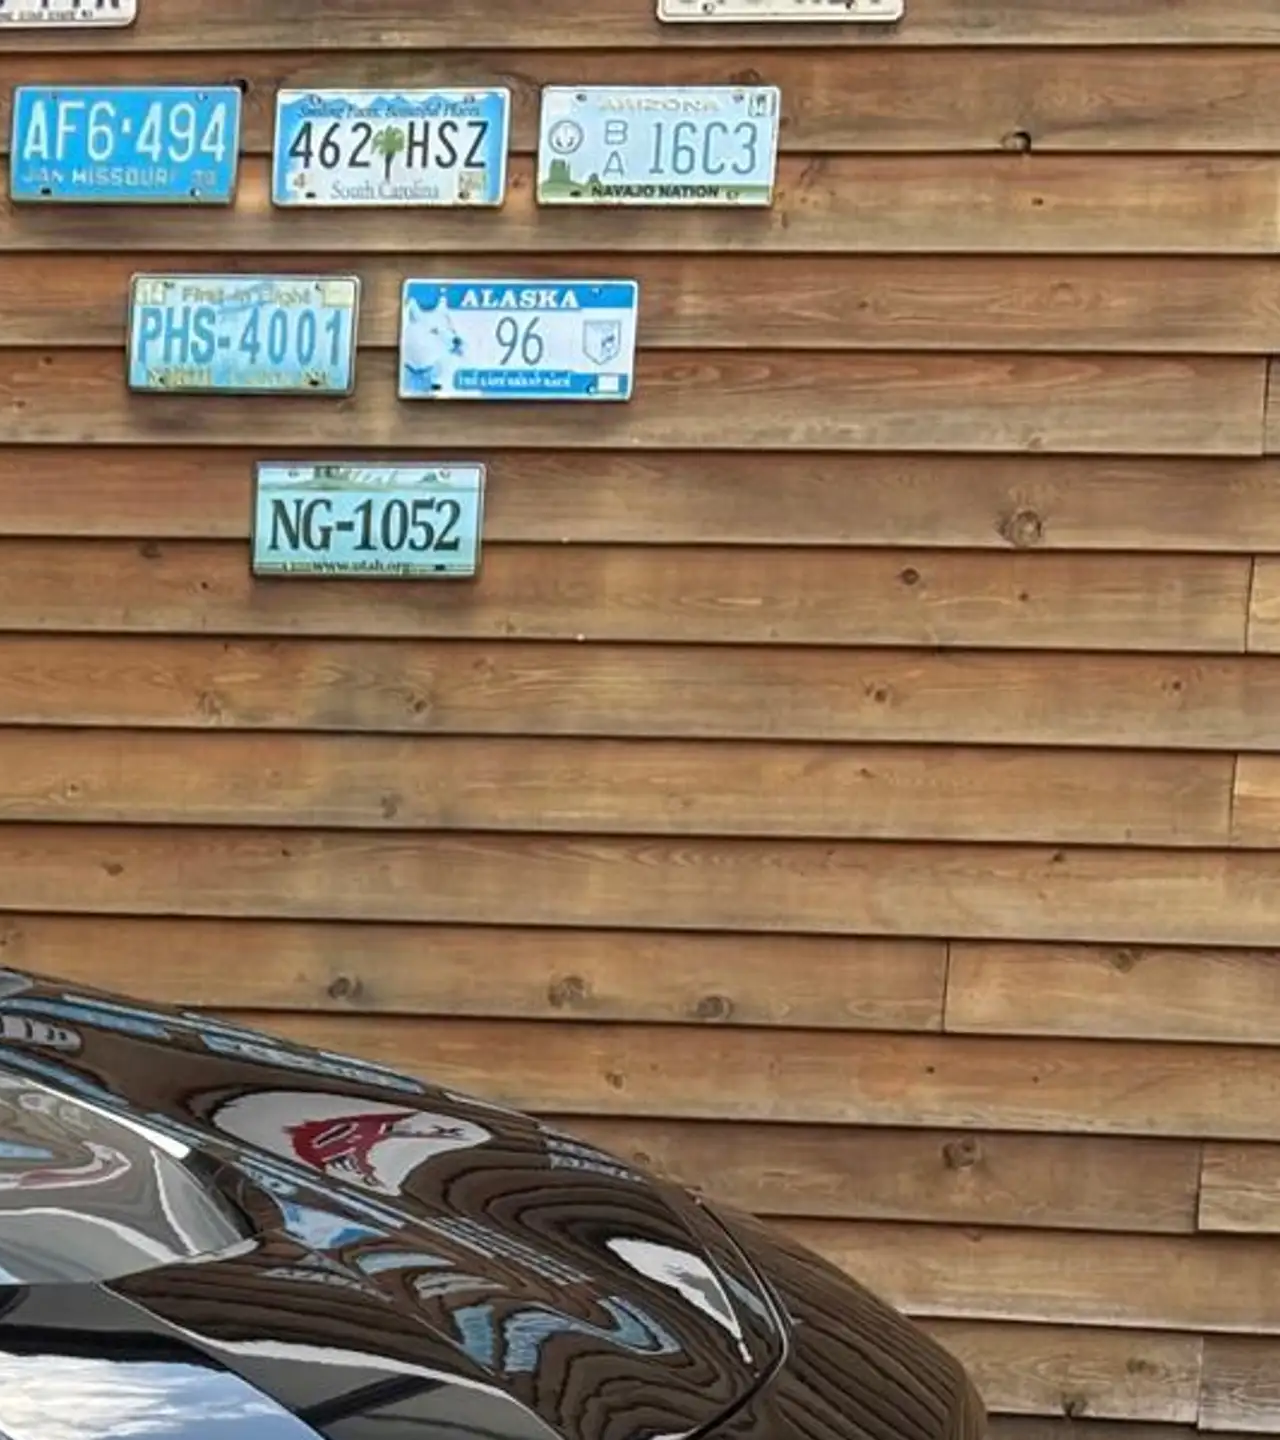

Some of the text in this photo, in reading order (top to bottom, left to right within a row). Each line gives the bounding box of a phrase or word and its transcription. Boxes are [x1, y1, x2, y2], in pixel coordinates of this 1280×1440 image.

[289, 120, 489, 169] 462 HSZ
[649, 121, 758, 175] 16C3
[591, 184, 720, 198] NAVAJO NATION
[461, 288, 579, 308] ALASKA
[138, 306, 341, 366] PHS-4001
[495, 316, 544, 365] 96
[268, 497, 461, 551] NG-1052
